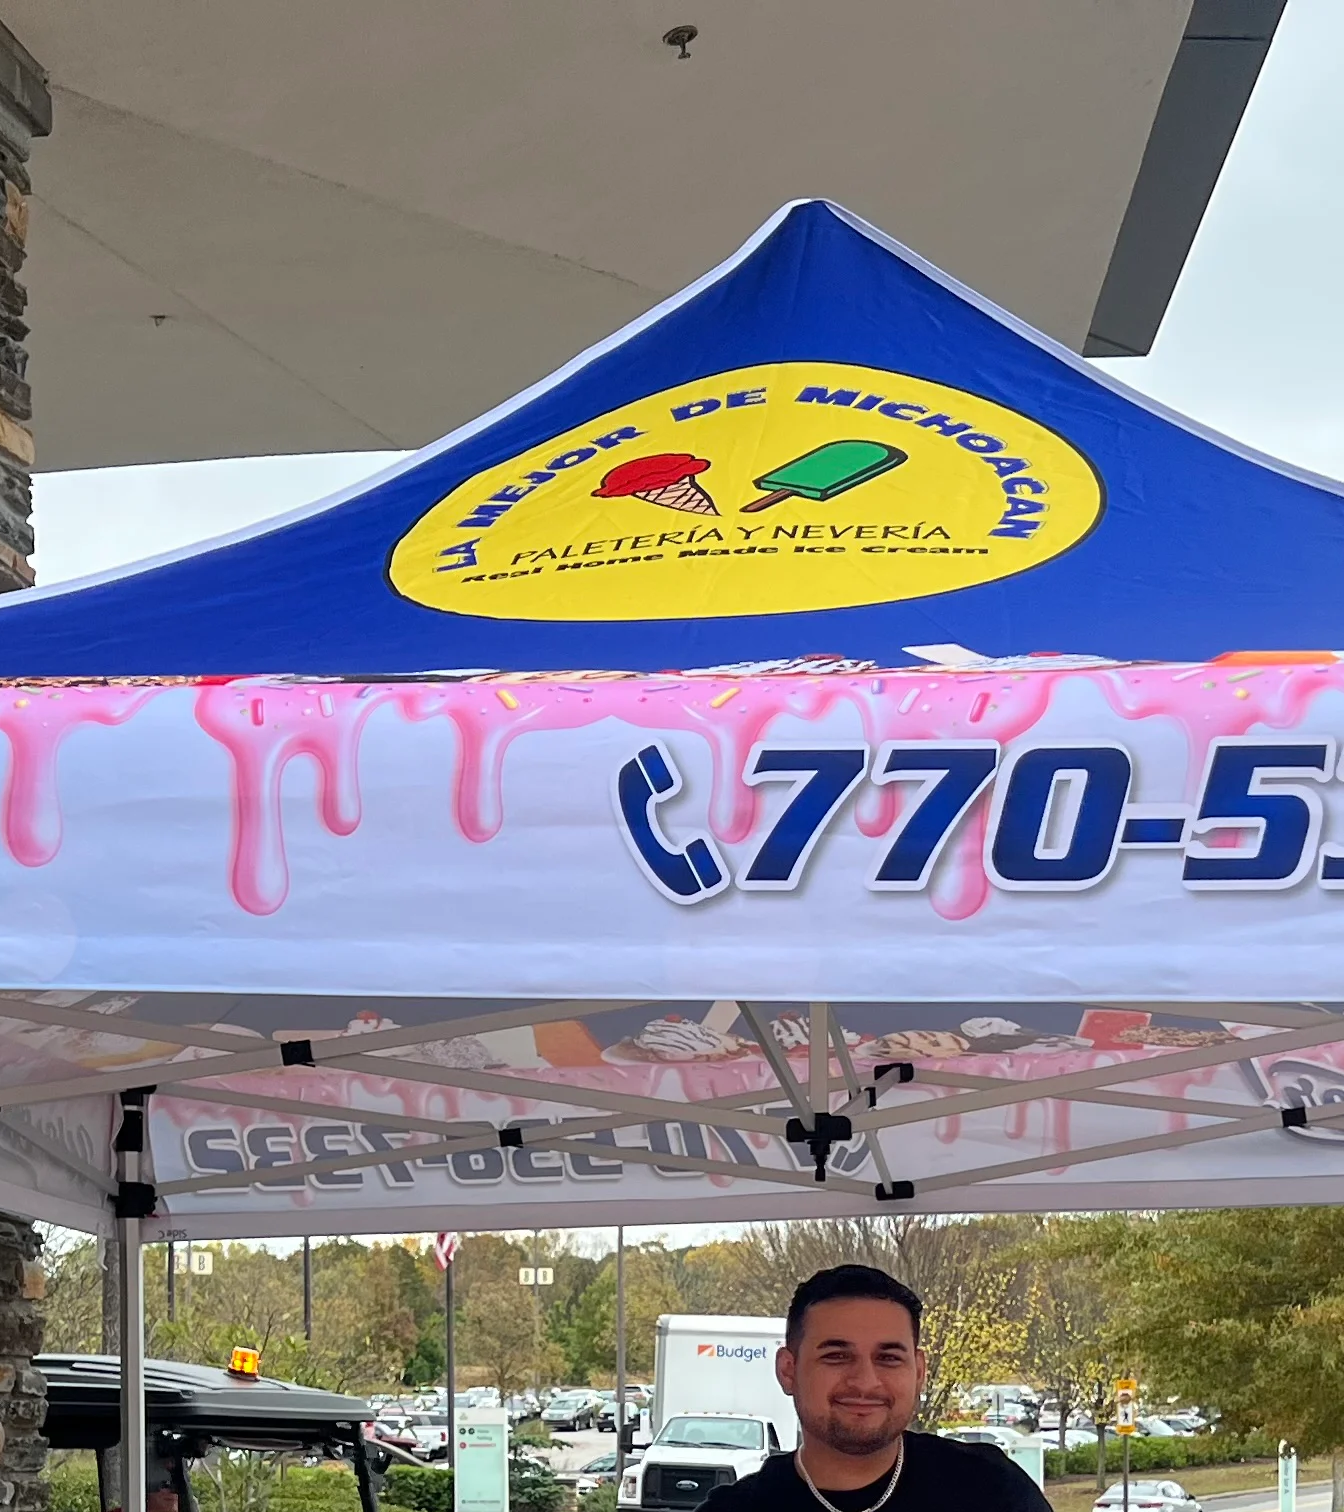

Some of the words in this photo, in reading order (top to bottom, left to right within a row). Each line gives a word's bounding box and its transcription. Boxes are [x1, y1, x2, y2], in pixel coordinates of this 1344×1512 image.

[670, 384, 769, 423] DE
[456, 423, 647, 529] MEJOR
[794, 384, 1052, 542] MICHOACAN
[432, 537, 482, 574] LA
[460, 565, 545, 584] Real
[555, 551, 665, 573] Home
[677, 544, 780, 560] Made
[793, 542, 847, 556] Ice
[861, 543, 991, 558] Cream
[512, 522, 726, 567] PALETERÍA
[730, 525, 755, 543] Y
[771, 520, 952, 543] NEVERÍA
[716, 1344, 767, 1362] Budget
